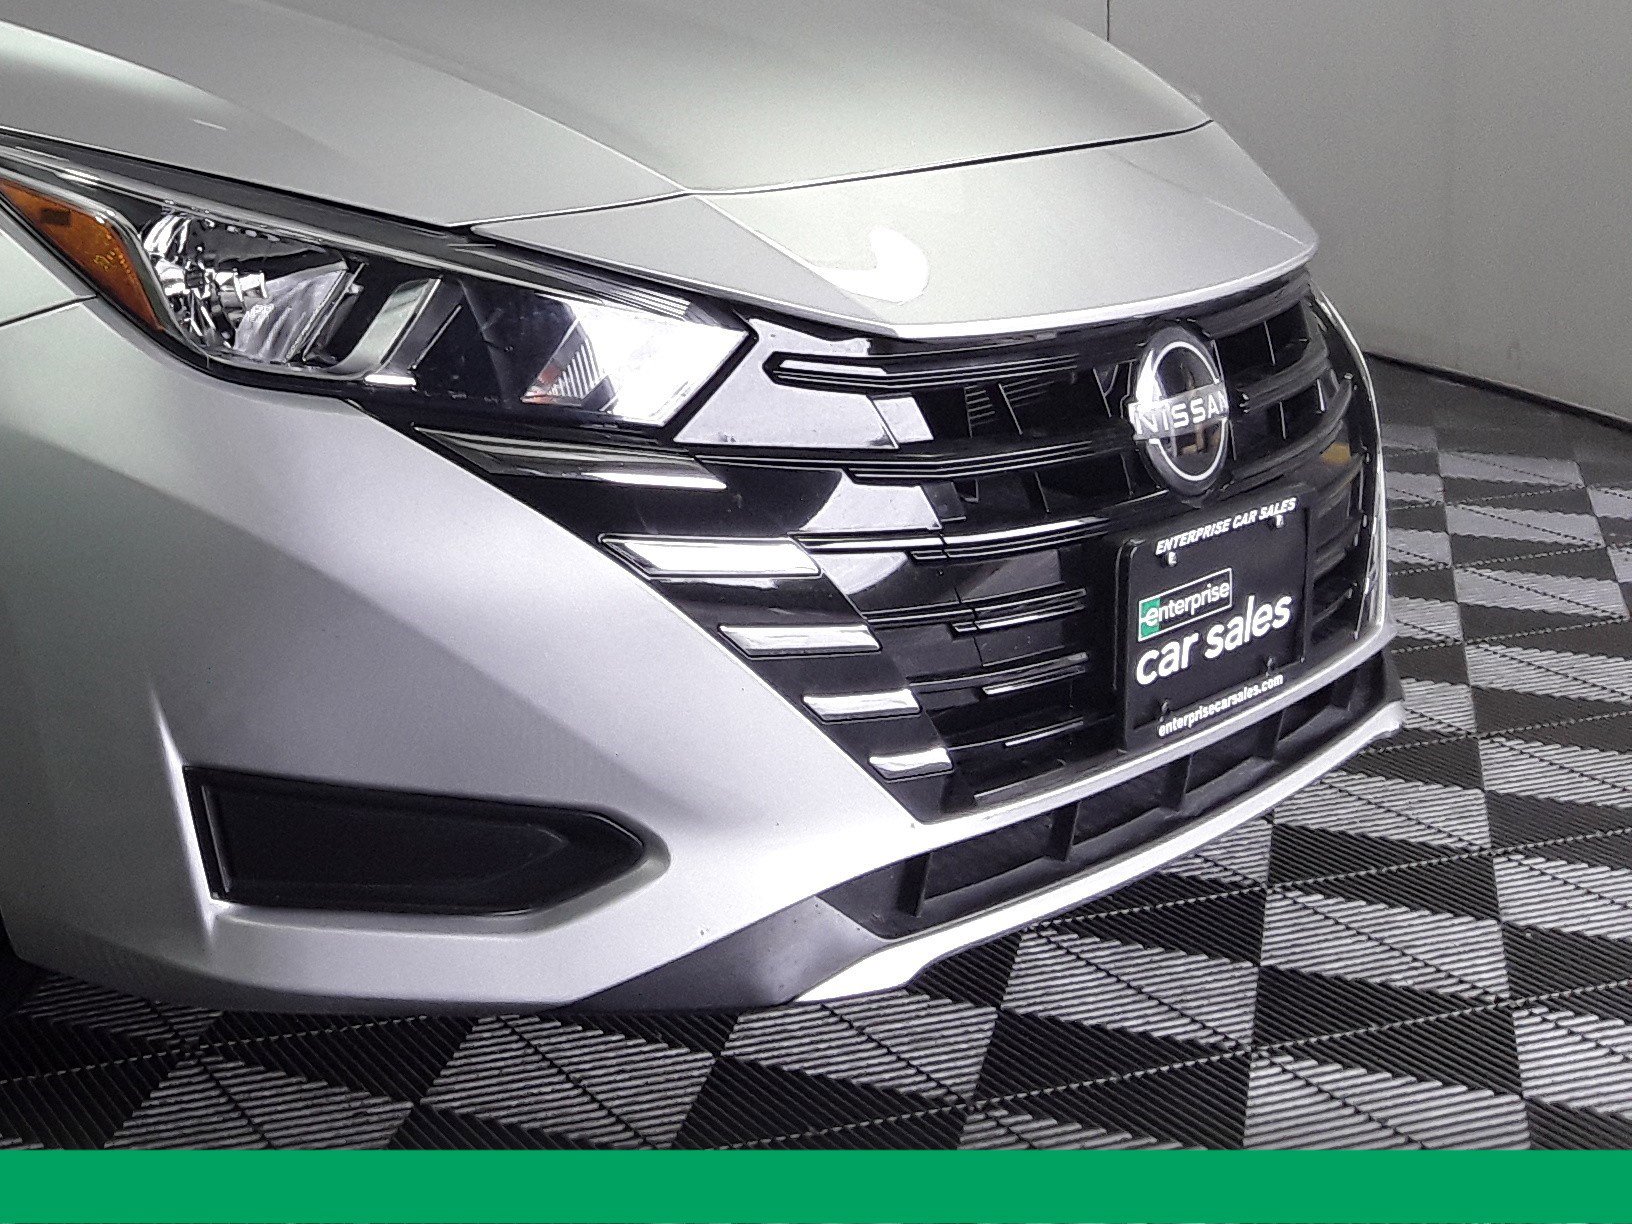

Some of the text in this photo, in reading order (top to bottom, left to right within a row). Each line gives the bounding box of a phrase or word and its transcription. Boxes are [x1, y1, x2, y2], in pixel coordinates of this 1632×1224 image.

[1133, 390, 1229, 434] NISSAN
[1155, 497, 1297, 555] ENTERPRISE CAR SALES
[1141, 583, 1230, 626] enterprise
[1136, 595, 1293, 685] car sales
[1158, 673, 1284, 737] enterprisecarsales.com
